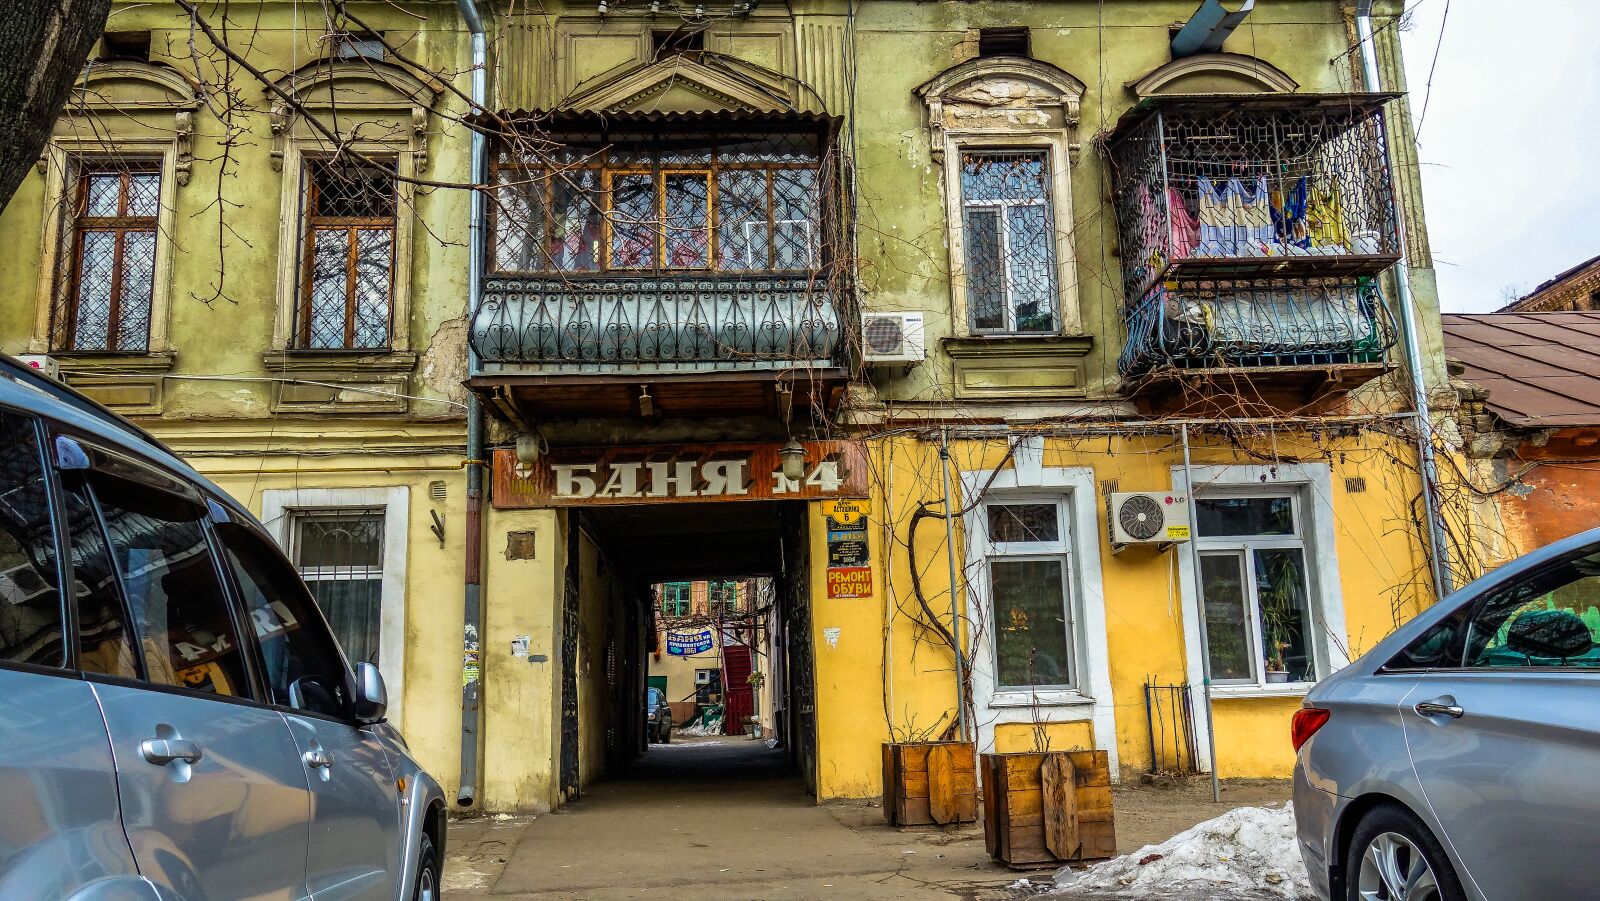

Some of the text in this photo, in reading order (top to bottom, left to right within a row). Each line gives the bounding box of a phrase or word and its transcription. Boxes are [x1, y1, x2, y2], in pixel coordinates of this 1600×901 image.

[550, 459, 748, 499] БАНЯ
[805, 461, 844, 492] 4
[1175, 496, 1185, 504] LG
[844, 513, 850, 522] 6
[828, 570, 871, 583] РЕМОНТ
[832, 582, 871, 595] ОБУВИ
[668, 634, 702, 643] БАНЯ
